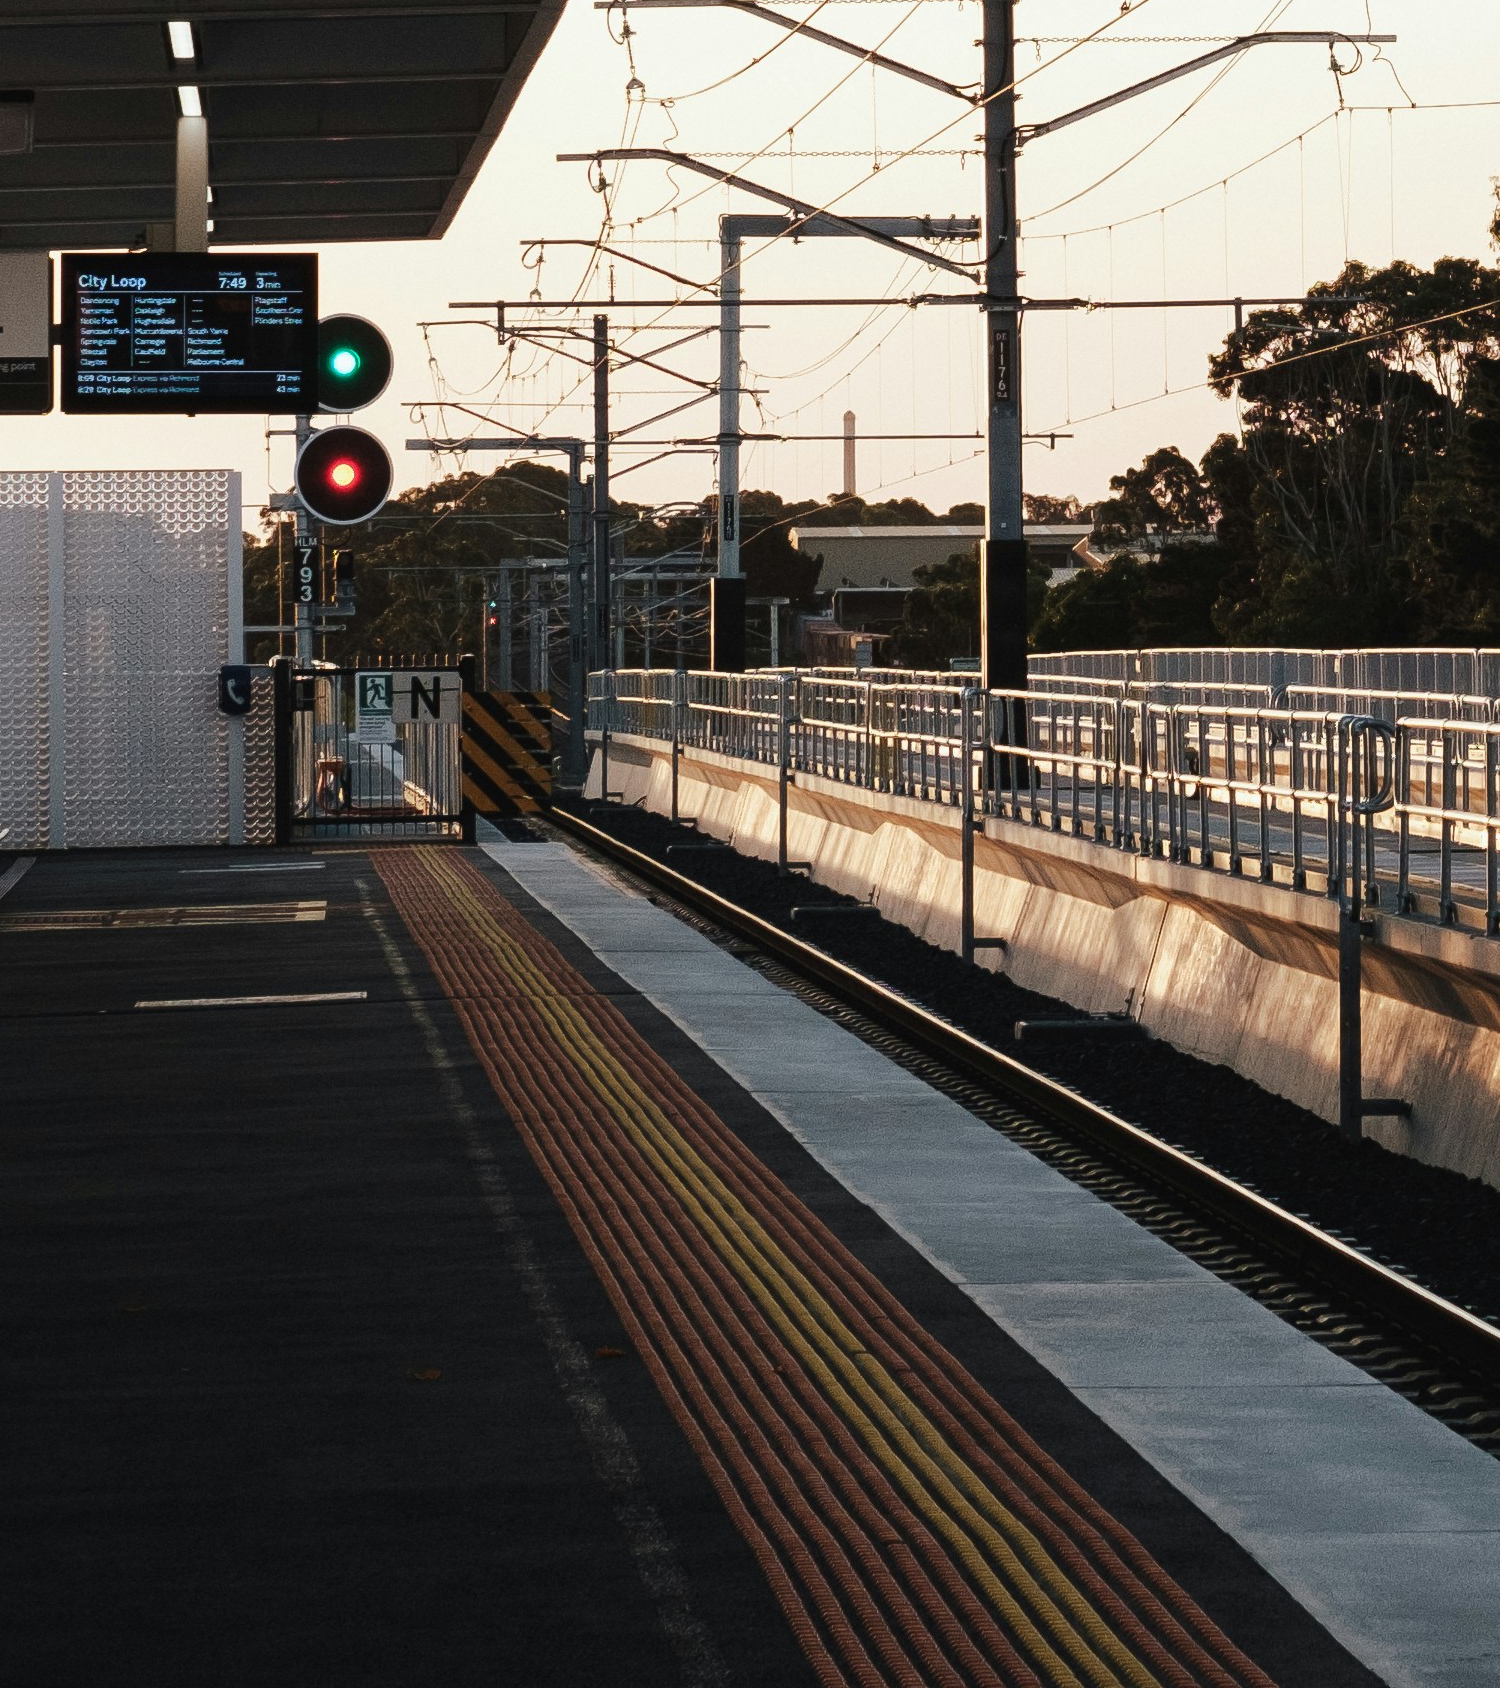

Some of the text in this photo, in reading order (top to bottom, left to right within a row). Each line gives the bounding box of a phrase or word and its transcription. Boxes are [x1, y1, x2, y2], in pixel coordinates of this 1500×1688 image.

[78, 275, 147, 290] City Loop
[218, 278, 247, 289] 7:49
[256, 278, 281, 289] 3 min
[254, 296, 288, 305] Flagstaff
[11, 362, 36, 372] point
[96, 375, 111, 383] City
[112, 375, 132, 383] Loop
[96, 386, 111, 395] City
[112, 386, 132, 394] Loop
[295, 537, 318, 547] HLM
[300, 548, 313, 602] 793
